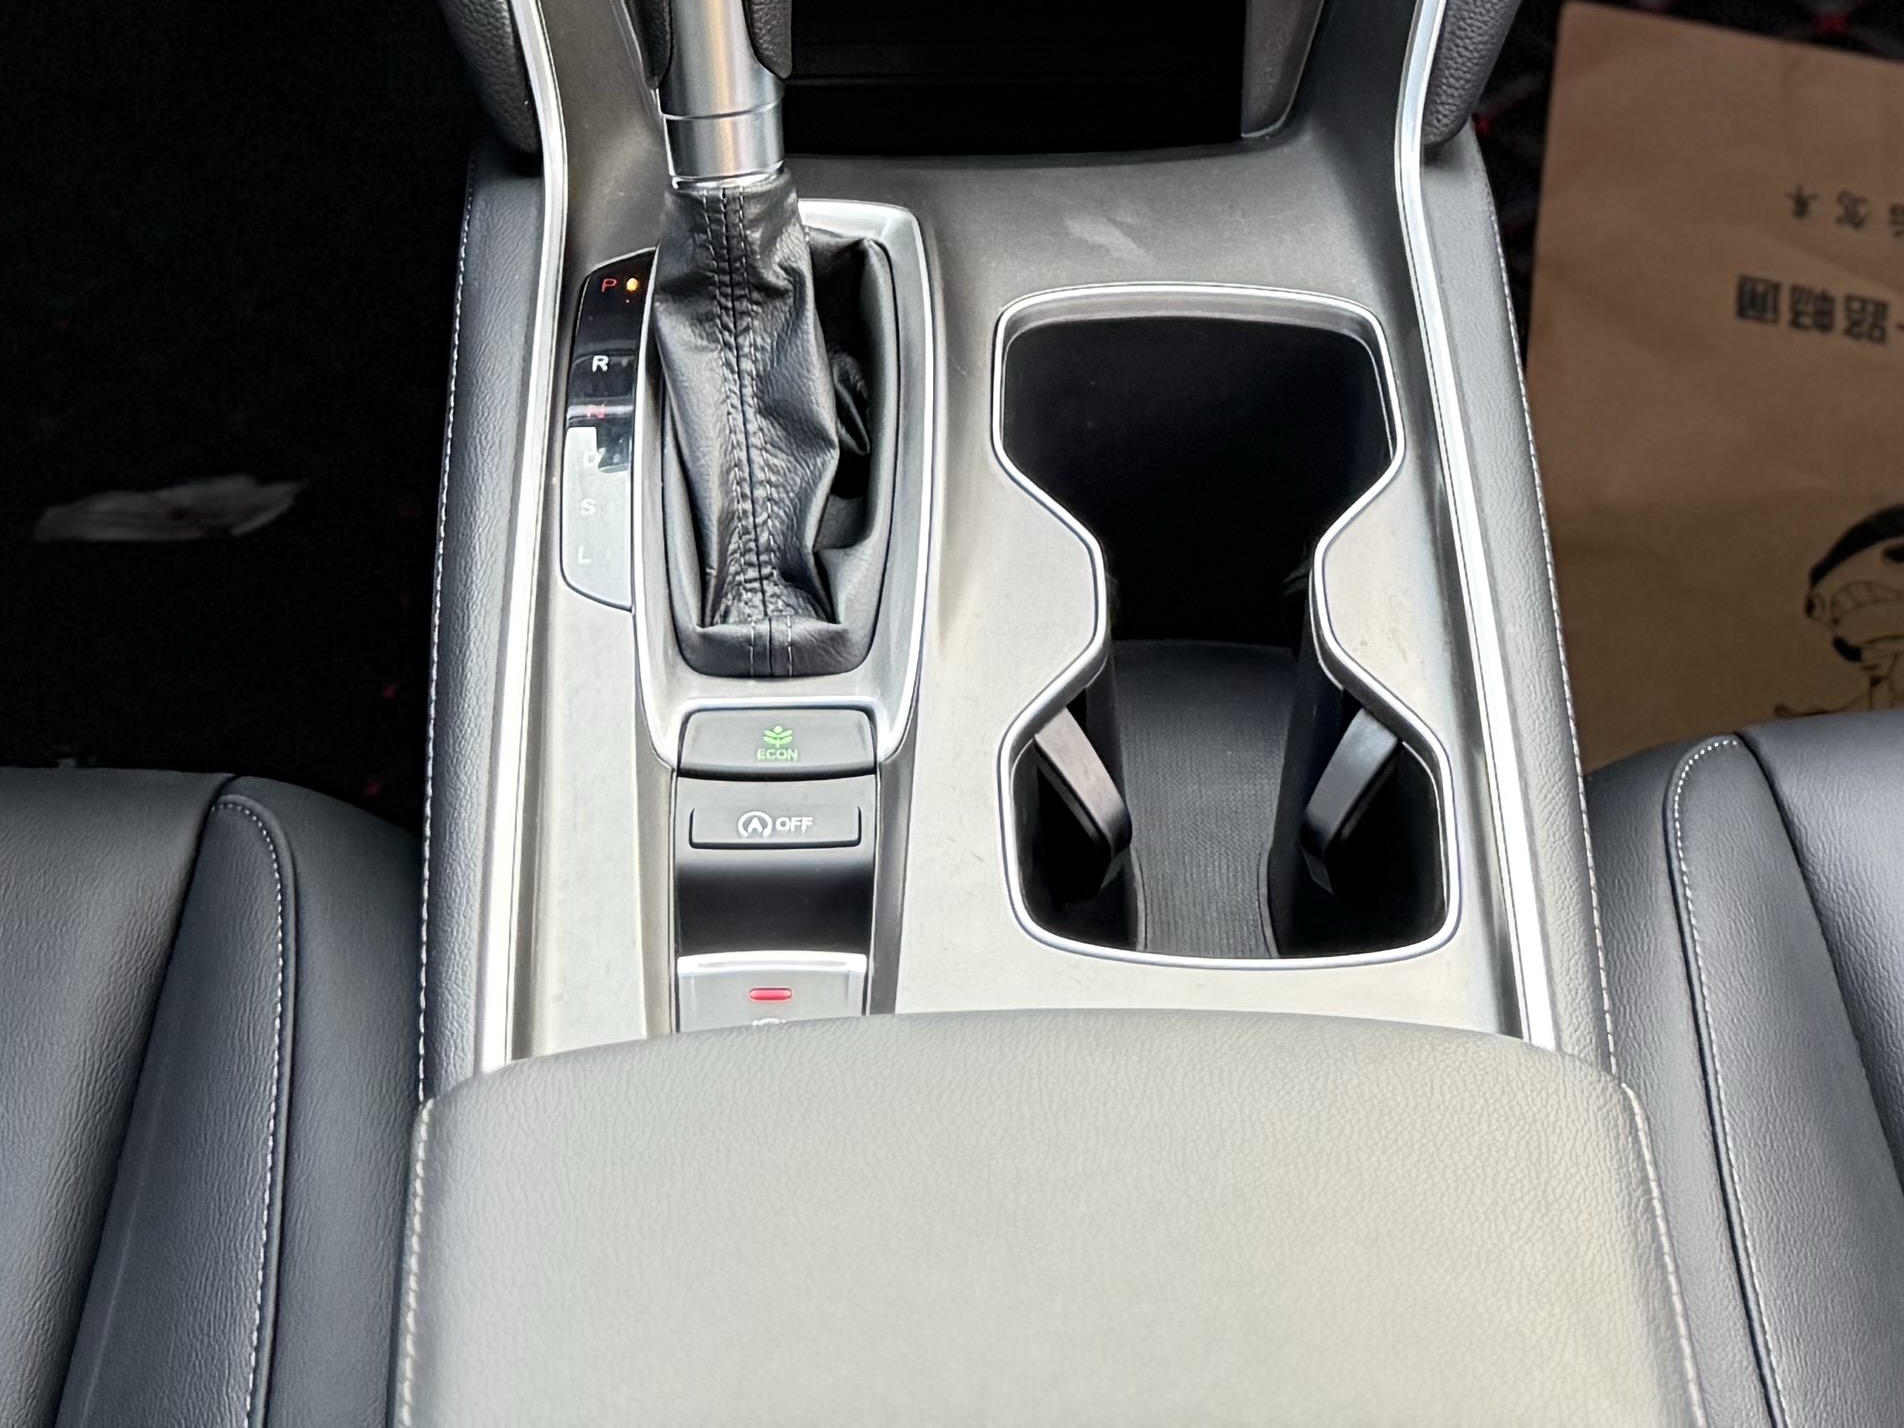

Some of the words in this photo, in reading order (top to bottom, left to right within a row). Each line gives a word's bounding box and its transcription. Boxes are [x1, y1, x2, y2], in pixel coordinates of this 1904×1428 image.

[601, 278, 618, 292] P
[592, 355, 609, 372] R
[581, 498, 596, 515] S
[578, 546, 592, 563] L
[756, 749, 798, 760] ECON
[776, 816, 814, 832] OFF
